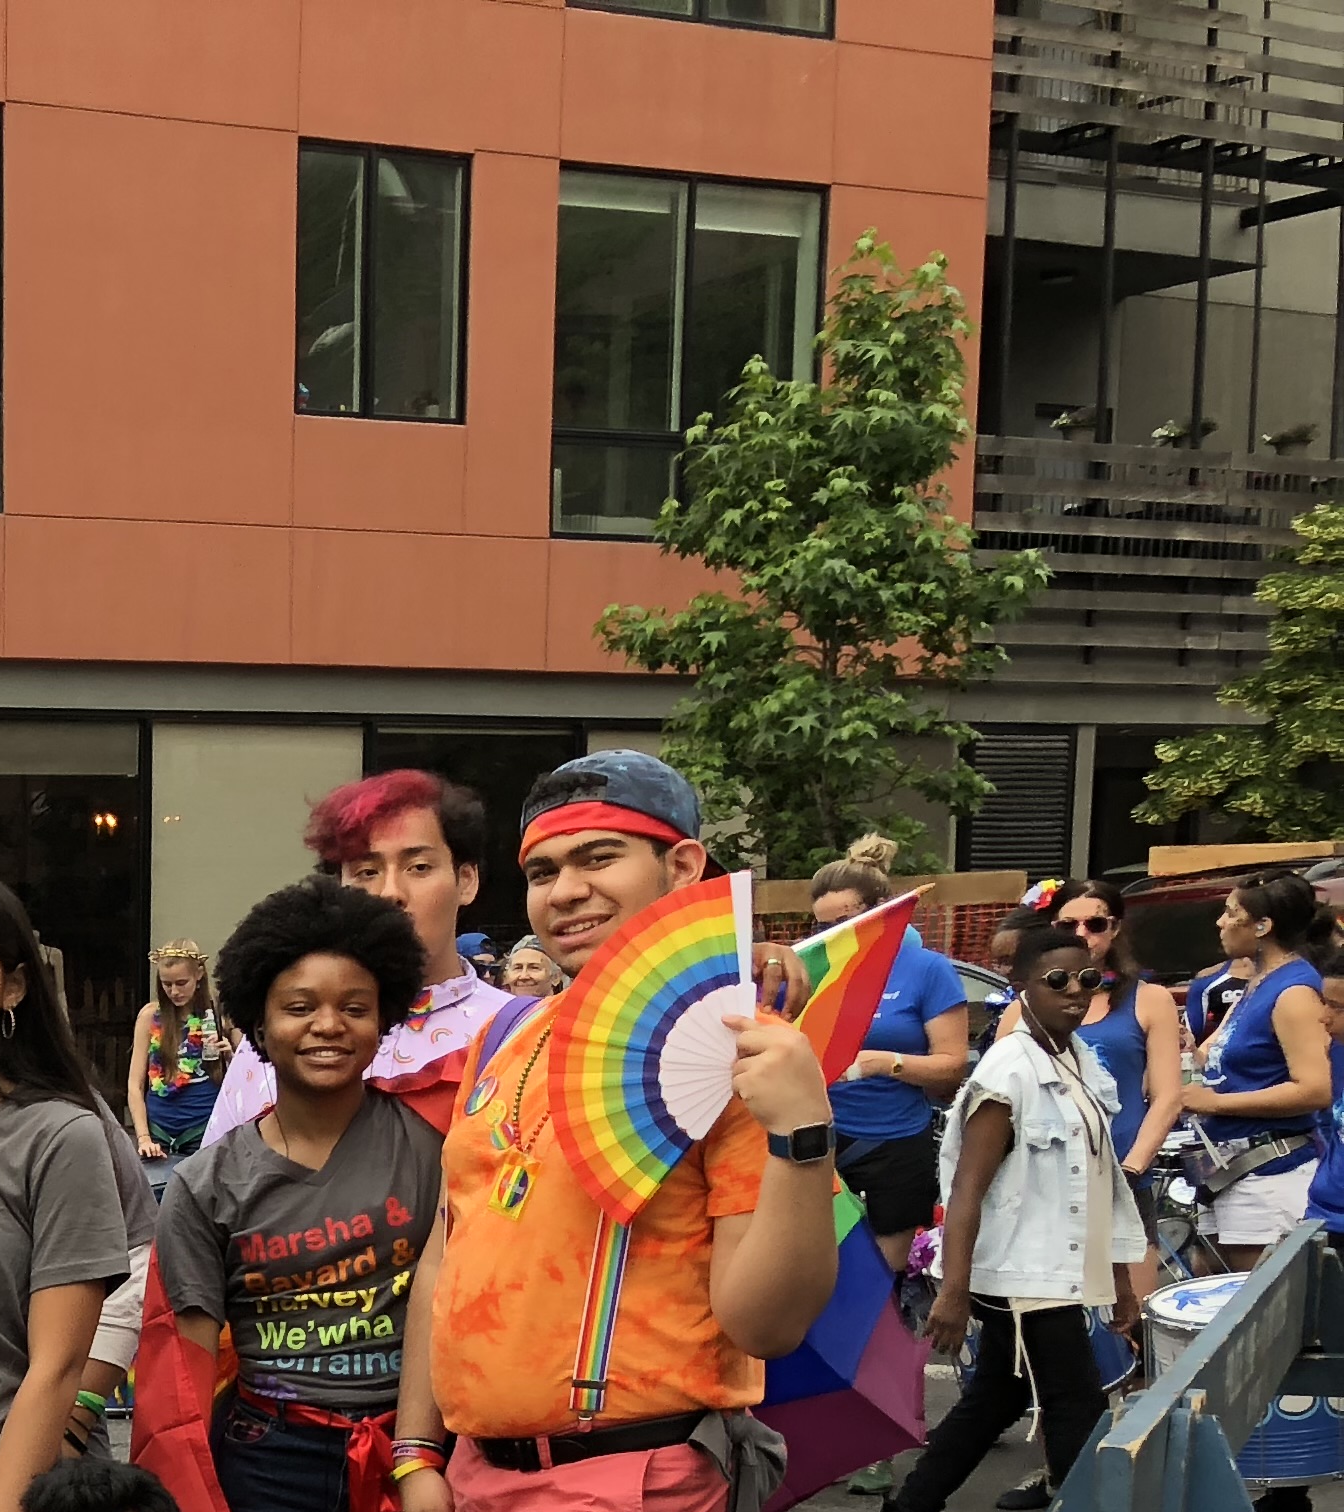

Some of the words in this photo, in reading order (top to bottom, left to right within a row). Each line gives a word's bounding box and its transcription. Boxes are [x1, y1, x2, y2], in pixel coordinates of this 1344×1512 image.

[239, 1214, 373, 1262] Marsha
[385, 1197, 413, 1227] &
[392, 1238, 415, 1267] &
[255, 1314, 394, 1350] We'wha
